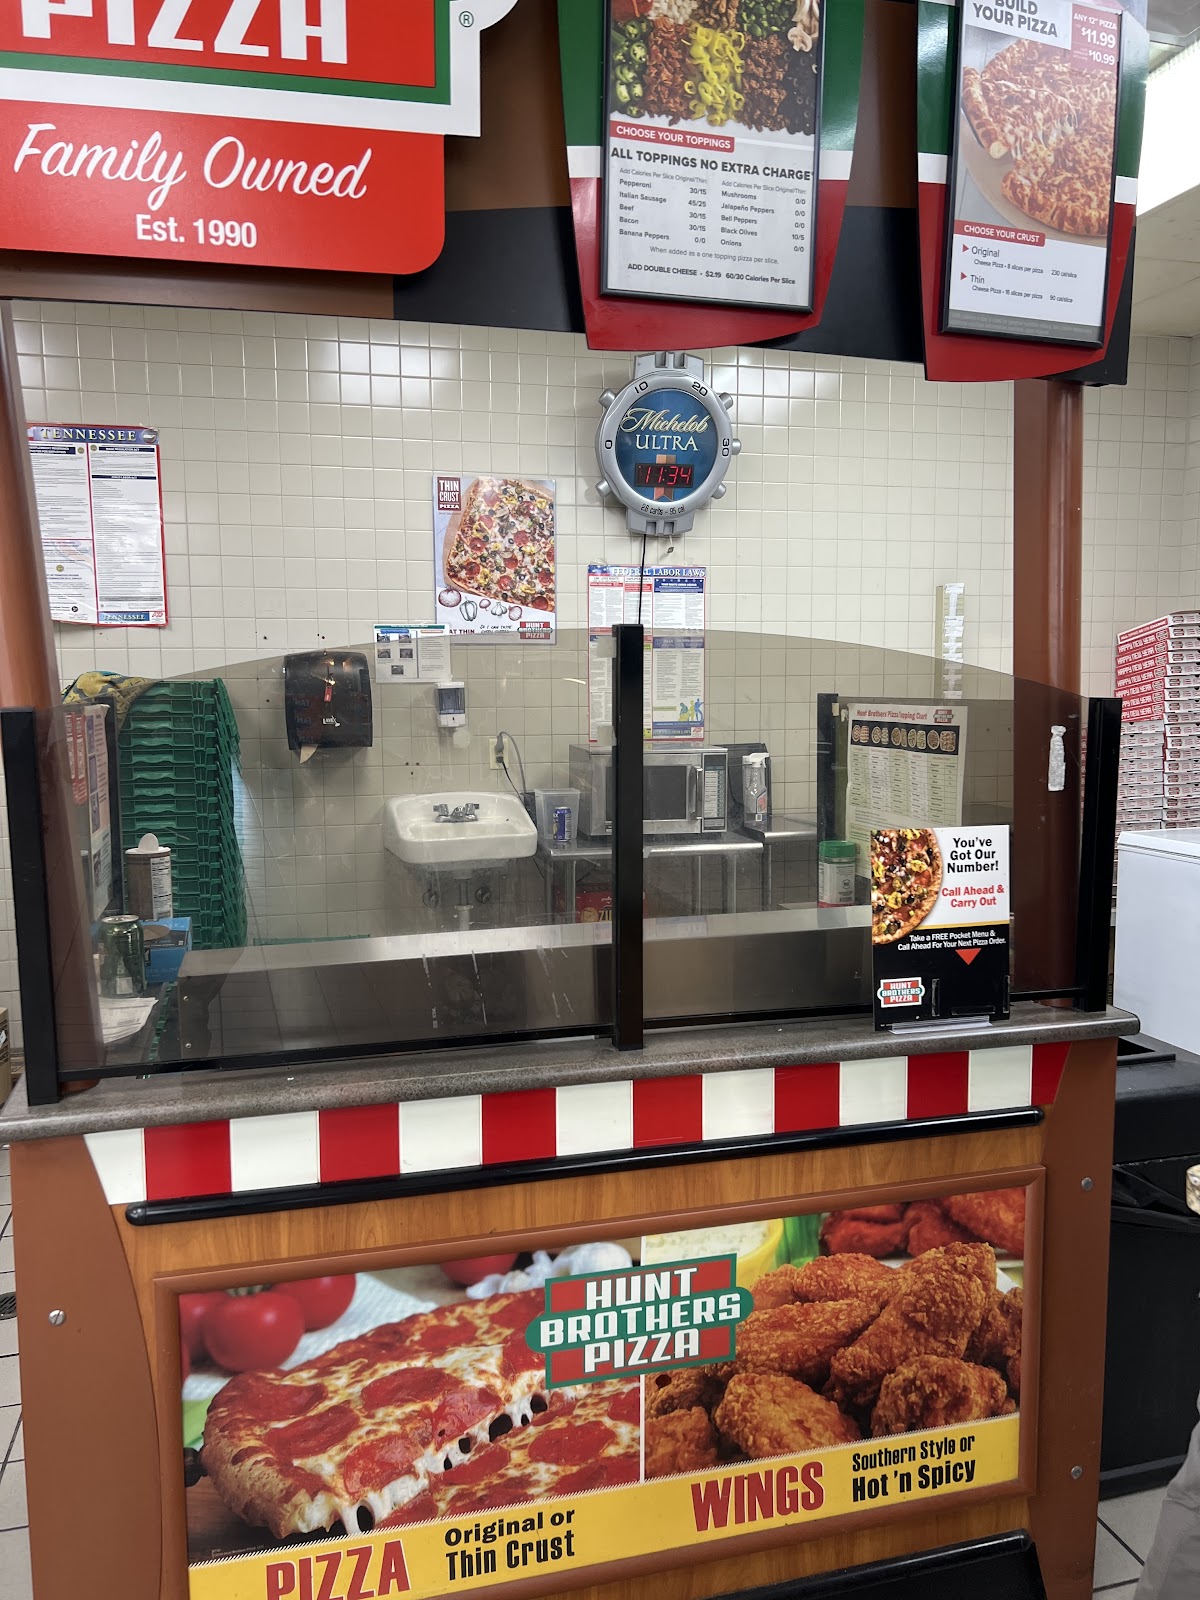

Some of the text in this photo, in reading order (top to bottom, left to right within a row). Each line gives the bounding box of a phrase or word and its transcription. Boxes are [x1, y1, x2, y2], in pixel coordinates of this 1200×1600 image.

[973, 2, 1058, 37] YOUR PIZZA
[1074, 13, 1087, 22] ANY
[21, 0, 348, 64] PIZZA
[1081, 27, 1115, 48] $11.99
[1089, 50, 1115, 65] $10.99
[616, 126, 731, 149] CHOOSE YOUR TOPPINGS
[13, 122, 374, 211] Family Owned
[611, 148, 632, 160] ALL
[636, 150, 697, 168] TOPPINGS
[700, 160, 718, 170] NO
[722, 162, 760, 176] EXTRA
[620, 179, 651, 189] Pepperoni
[640, 194, 667, 203] Sausage
[722, 191, 757, 200] Mushrooms
[750, 206, 774, 214] Peppers
[136, 214, 257, 249] Est. 1990
[619, 229, 669, 240] Banana Peppers
[964, 225, 1040, 242] CHOOSE YOUR CRUST
[714, 253, 736, 262] topping
[971, 246, 1000, 258] Original
[644, 265, 670, 274] DOUBLE
[672, 267, 697, 276] CHEESE
[746, 274, 769, 283] Calories
[970, 275, 985, 284] Thin
[634, 381, 648, 394] 10
[692, 381, 708, 397] 20
[620, 408, 712, 433] Michelob
[41, 428, 136, 441] TENNESSEE
[636, 434, 698, 451] ULTRA
[723, 438, 729, 457] 30
[645, 466, 692, 485] 11:34
[439, 480, 459, 491] THIN
[440, 492, 459, 502] CRUST
[670, 507, 676, 515] 95
[653, 568, 680, 576] LABOR
[683, 568, 705, 576] LAWS
[1119, 635, 1155, 652] HAPPY NEW YEAR
[953, 837, 992, 848] You've
[950, 849, 996, 860] Got Our
[947, 861, 999, 873] Number!
[941, 885, 1004, 897] Call Ahead &
[950, 896, 997, 908] Carry Out
[882, 988, 921, 996] BROTHERS
[586, 1267, 698, 1310] HUNT
[540, 1293, 740, 1348] BROTHERS
[584, 1328, 699, 1373] PIZZA
[852, 1435, 975, 1472] Southern Style or
[852, 1475, 888, 1502] Hot
[918, 1459, 976, 1490] Spicy
[690, 1461, 825, 1532] WINGS
[444, 1509, 575, 1546] Original or
[446, 1529, 575, 1581] Thin Crust
[266, 1540, 411, 1600] PIZZA
